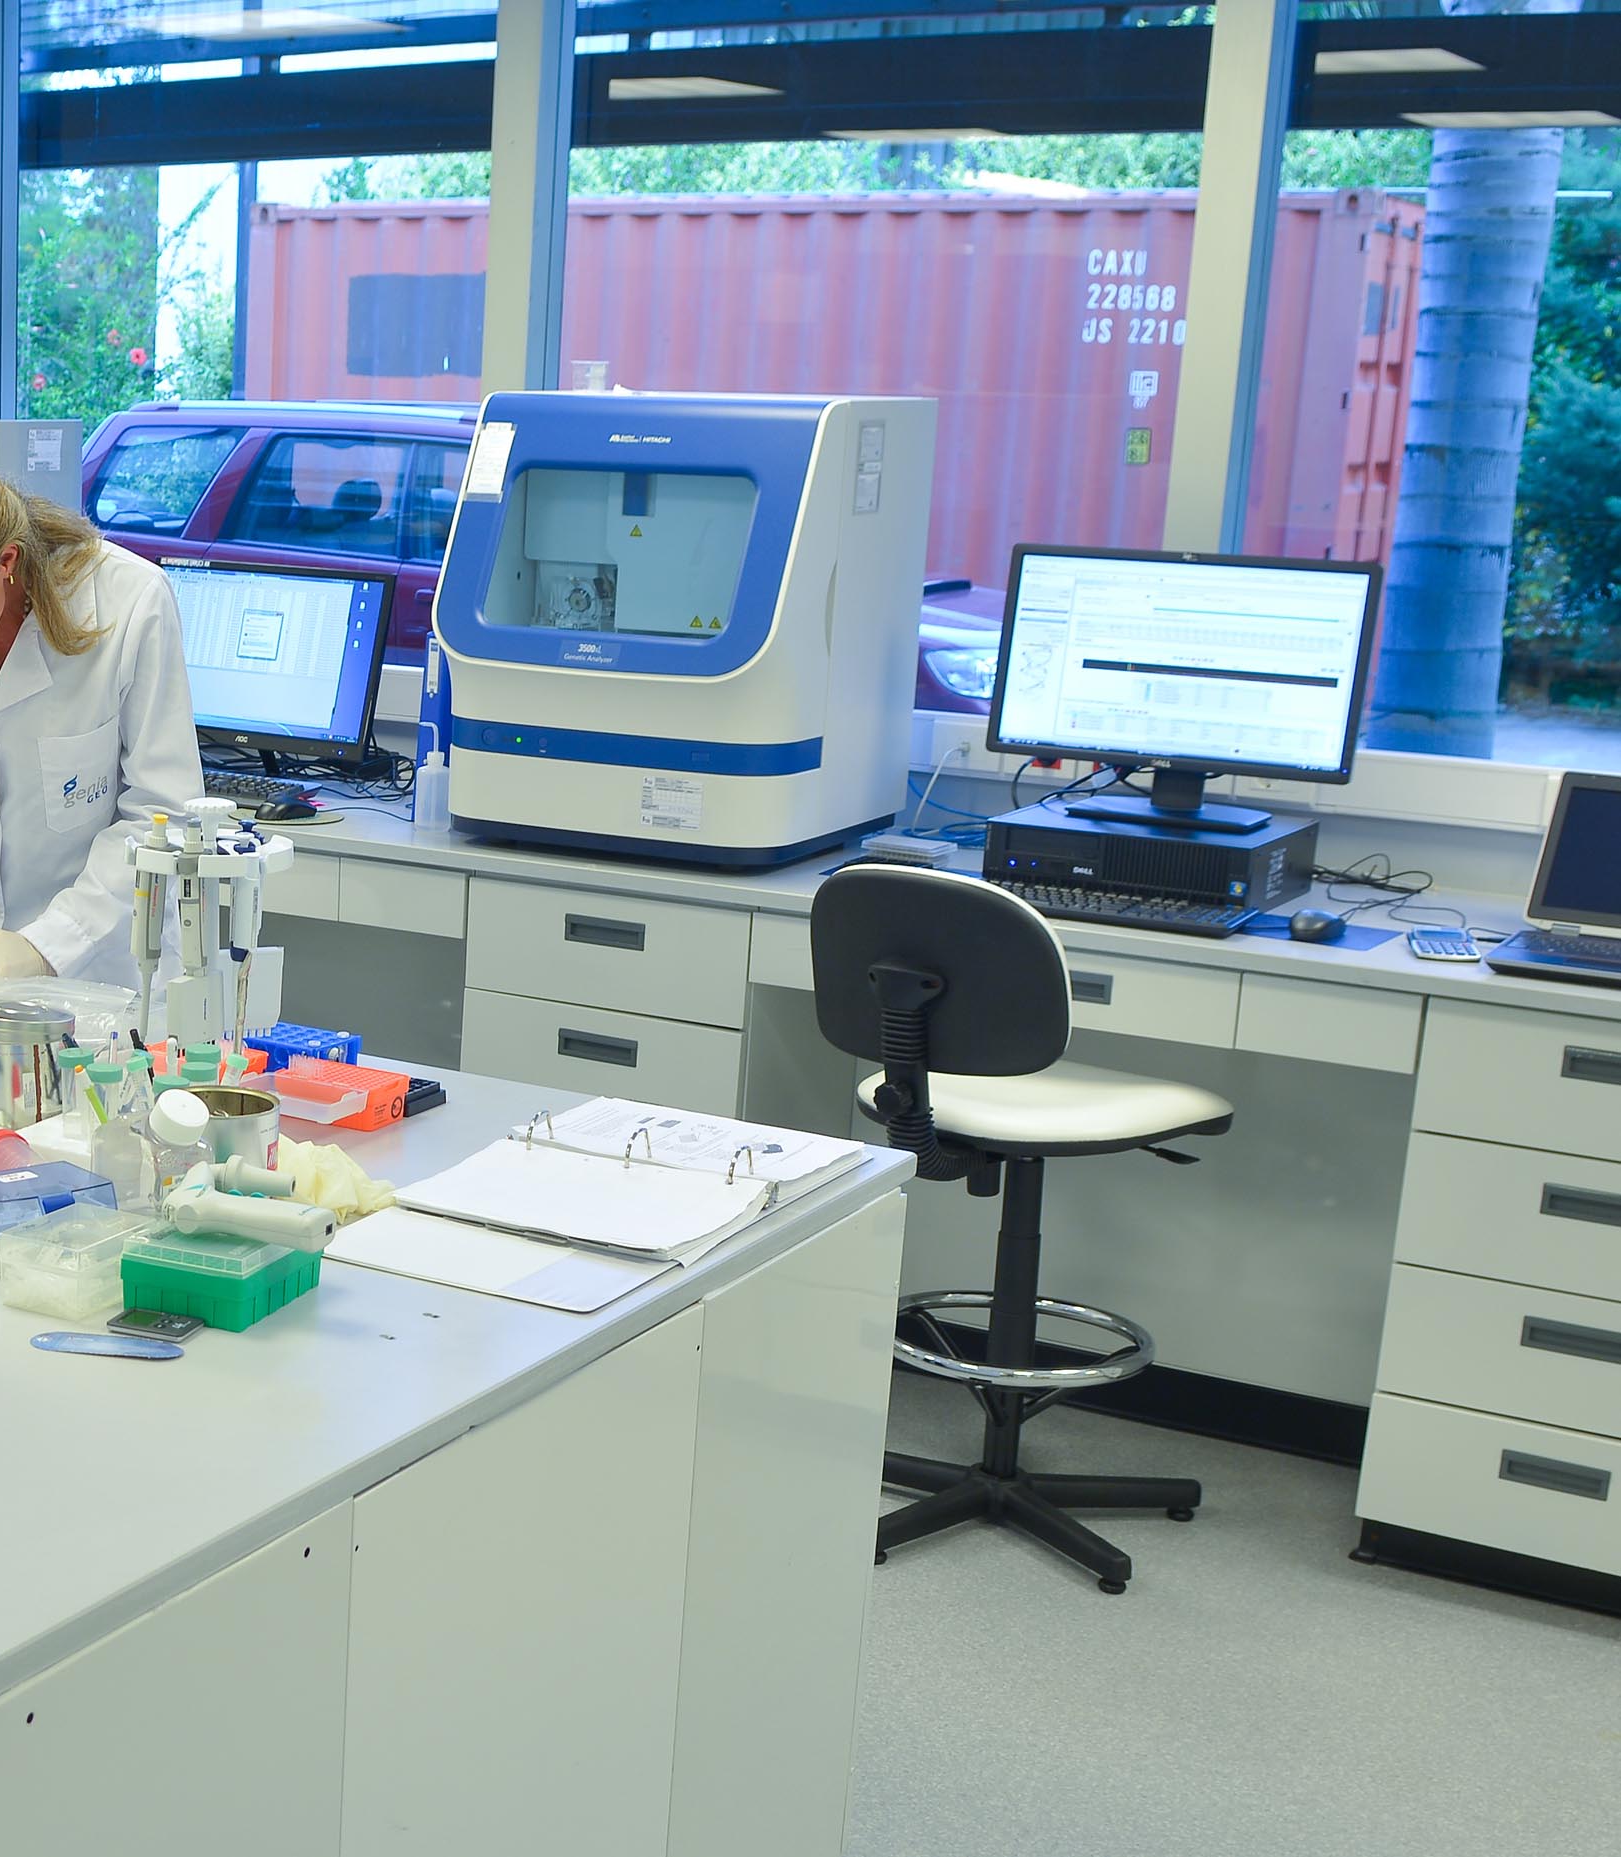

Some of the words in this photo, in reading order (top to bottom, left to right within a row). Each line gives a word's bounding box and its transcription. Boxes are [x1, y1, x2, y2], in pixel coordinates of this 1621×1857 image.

[1087, 248, 1148, 277] CAXU
[1086, 283, 1177, 312] 228568
[1127, 317, 1187, 346] 2210
[64, 776, 108, 809] genia
[87, 785, 108, 804] GEO
